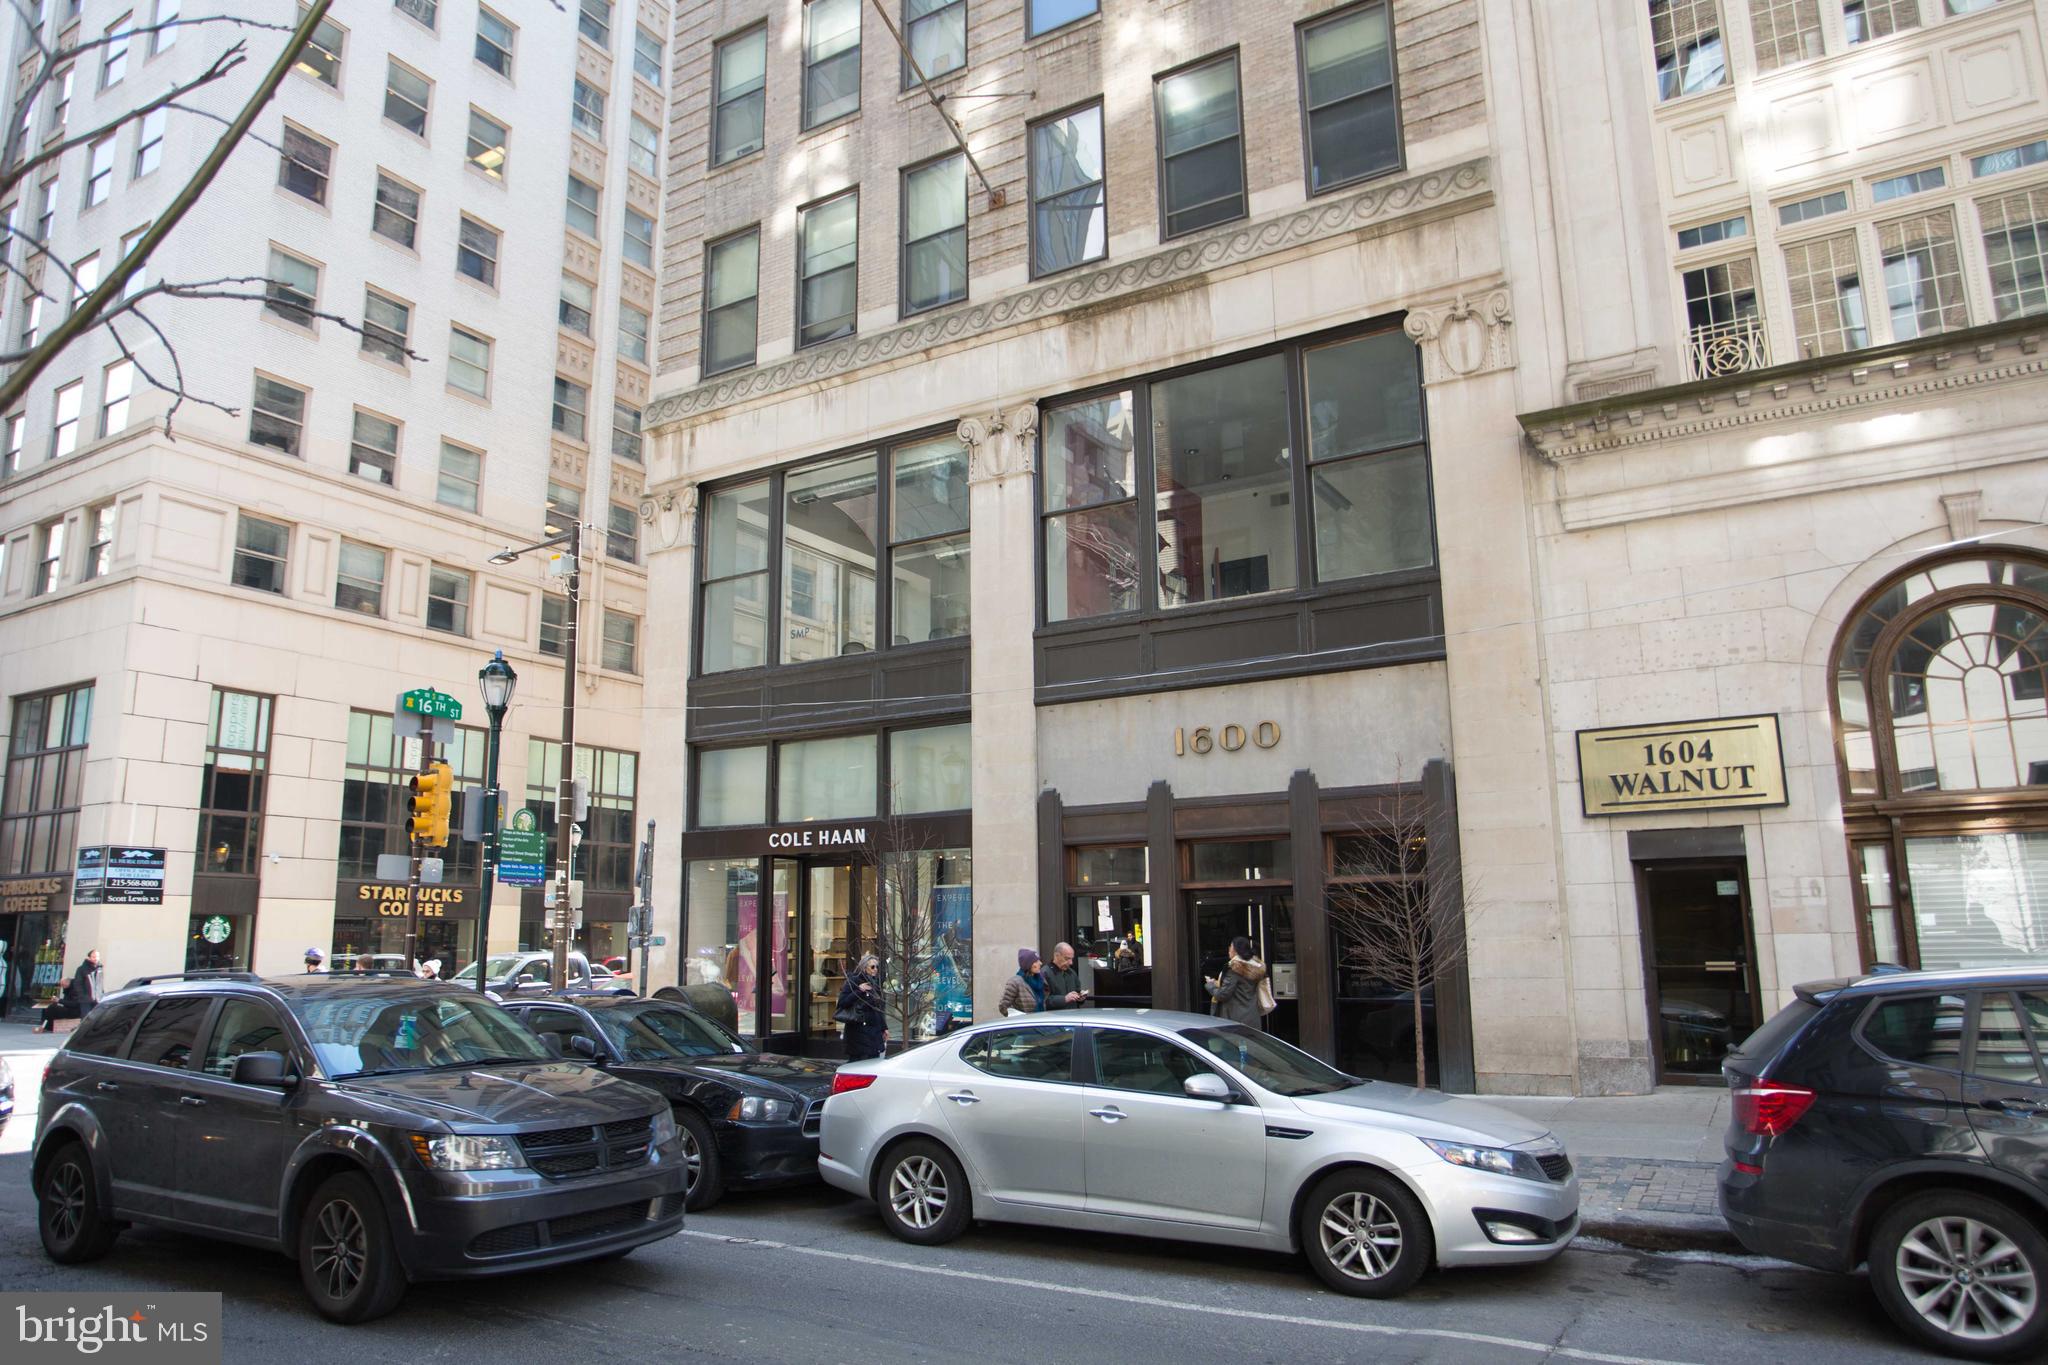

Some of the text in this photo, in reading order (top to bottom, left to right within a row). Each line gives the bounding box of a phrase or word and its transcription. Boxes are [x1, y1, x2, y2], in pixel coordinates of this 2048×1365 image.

[449, 708, 460, 718] ST
[1175, 720, 1281, 756] 1600
[1643, 739, 1713, 766] 1604
[1608, 765, 1755, 797] WALNUT
[769, 828, 865, 848] COLE HAAN
[111, 879, 159, 888] 215-568-8000
[4, 896, 48, 912] COFFEE
